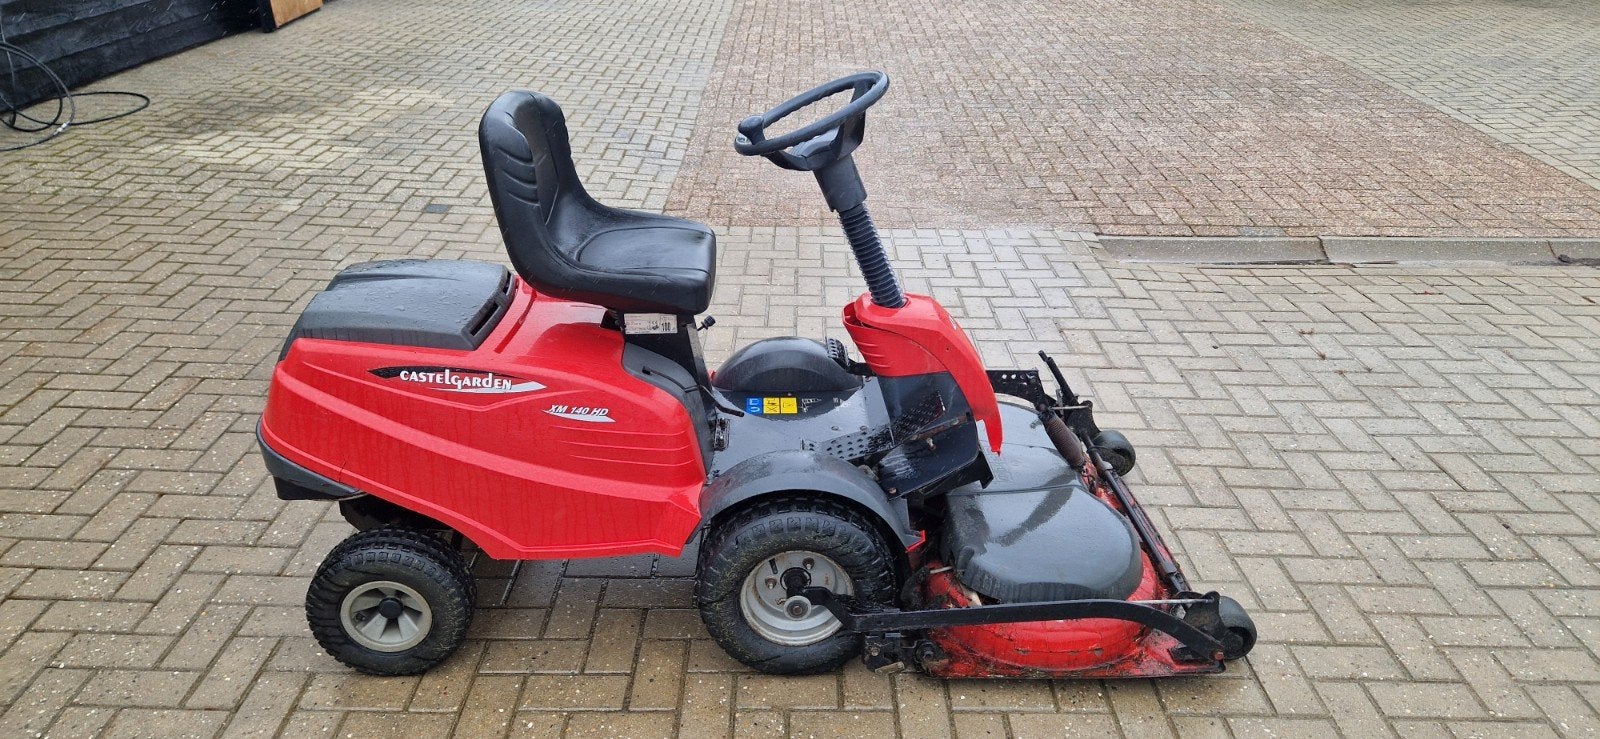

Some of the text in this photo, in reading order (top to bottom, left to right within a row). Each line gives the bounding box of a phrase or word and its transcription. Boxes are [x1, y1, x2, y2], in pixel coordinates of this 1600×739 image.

[549, 404, 609, 417] XM 140 HD
